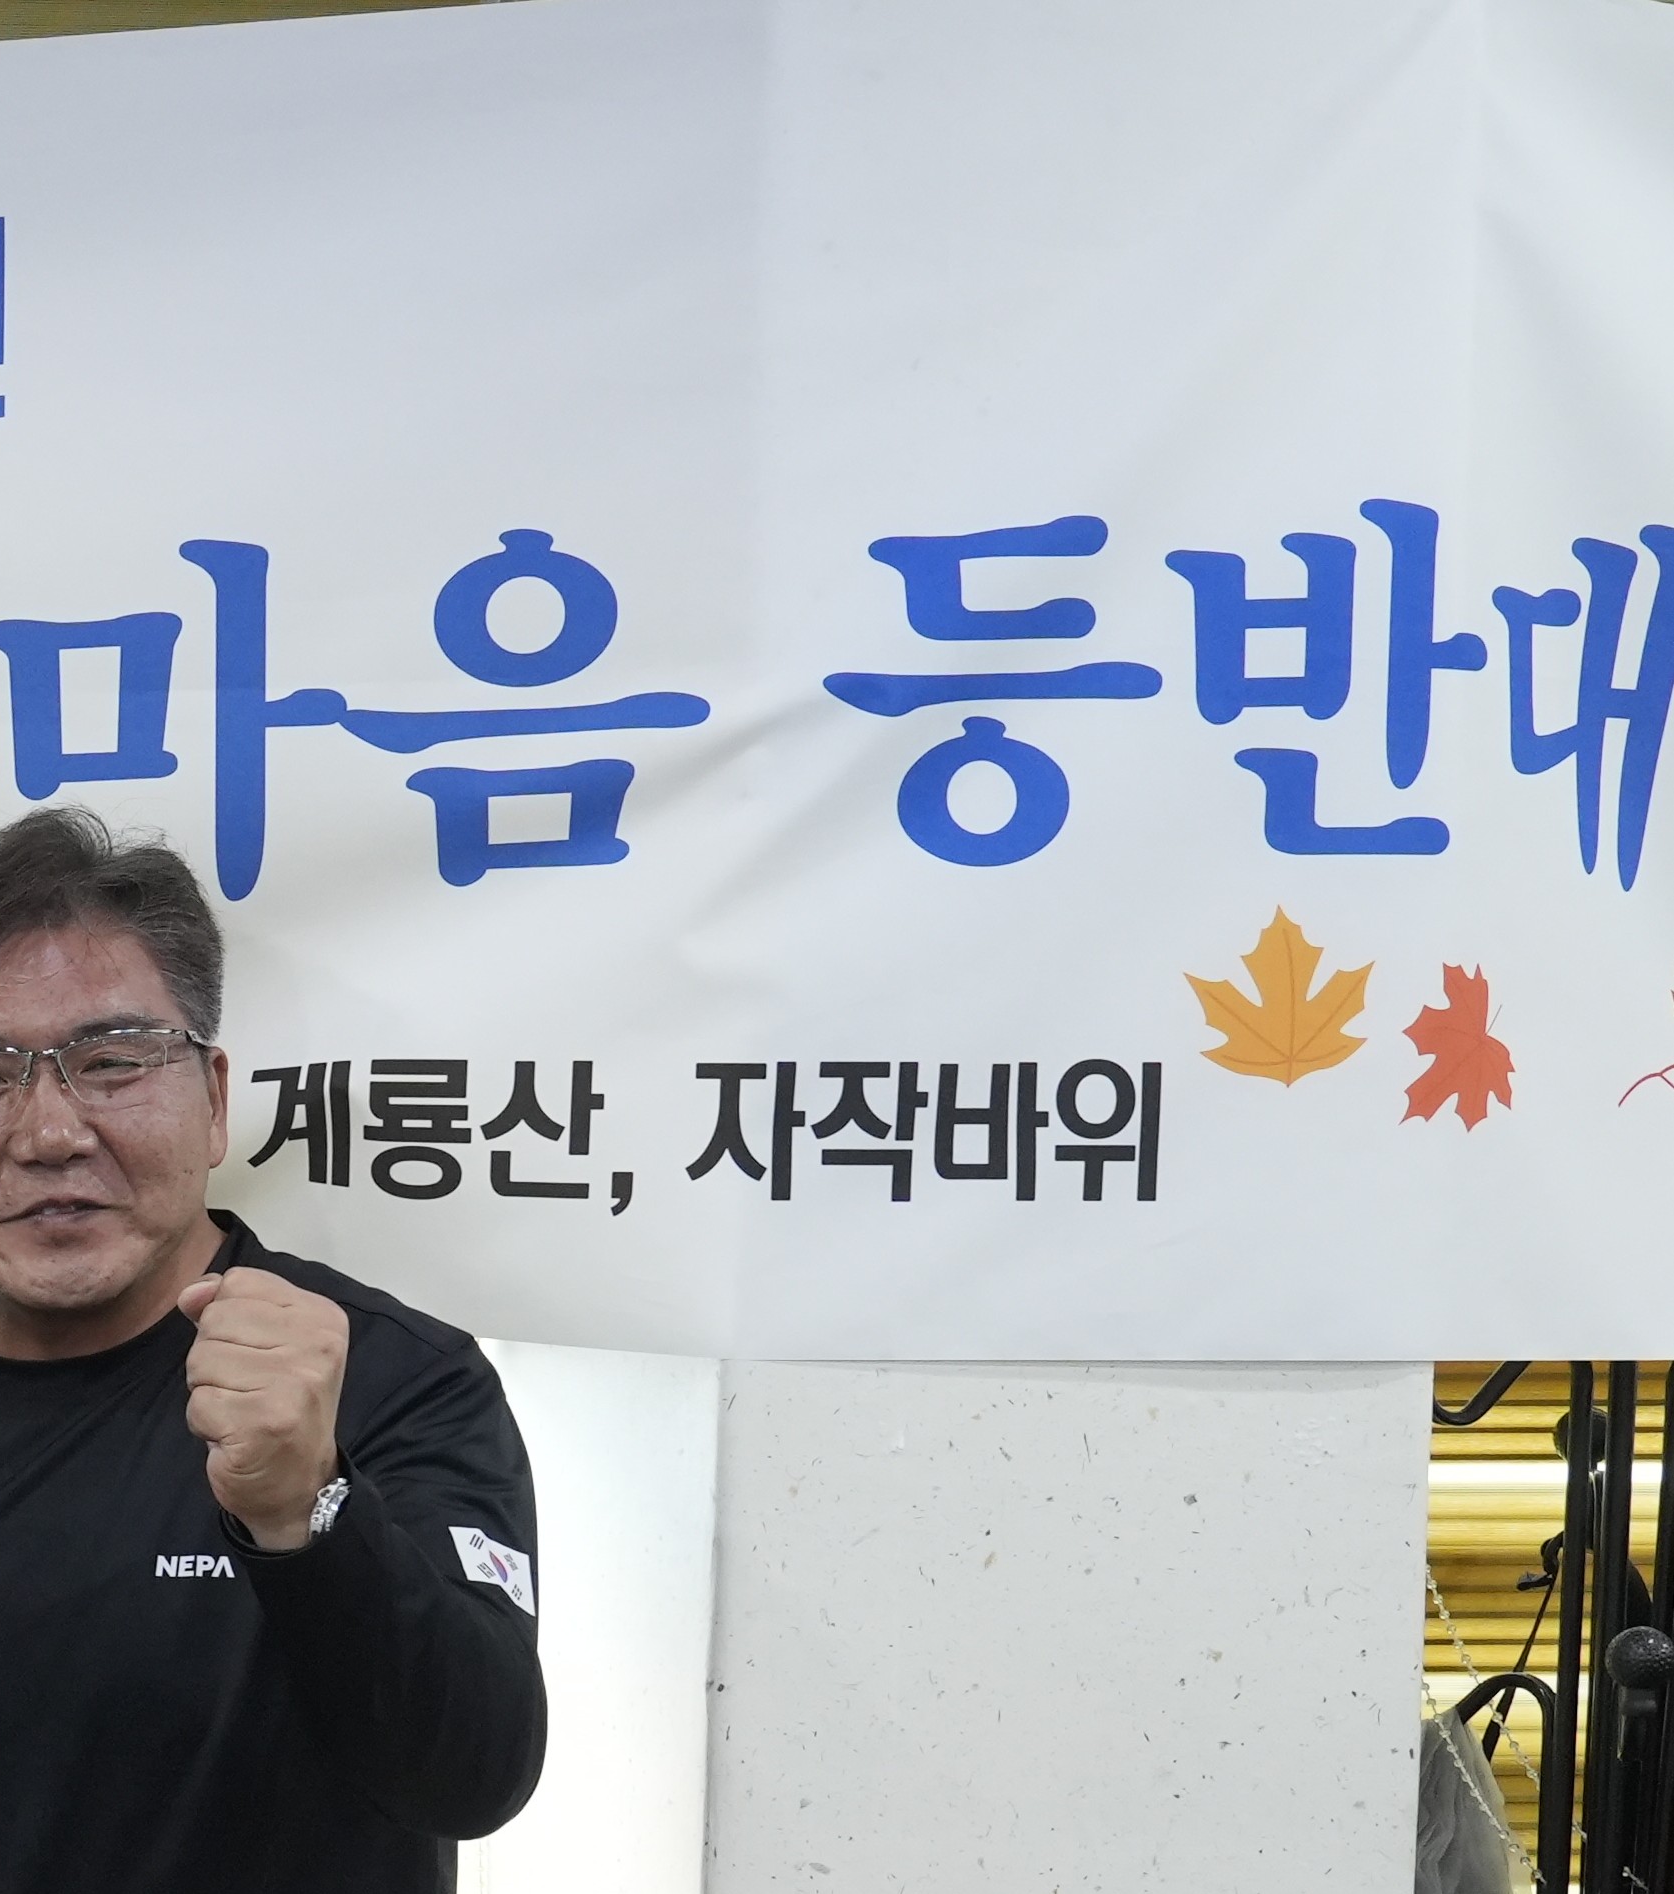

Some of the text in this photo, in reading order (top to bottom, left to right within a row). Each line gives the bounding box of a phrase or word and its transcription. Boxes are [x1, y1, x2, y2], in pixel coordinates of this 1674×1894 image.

[249, 1058, 1163, 1217] 계룡산, 자작바위
[154, 1554, 236, 1579] NEPA
